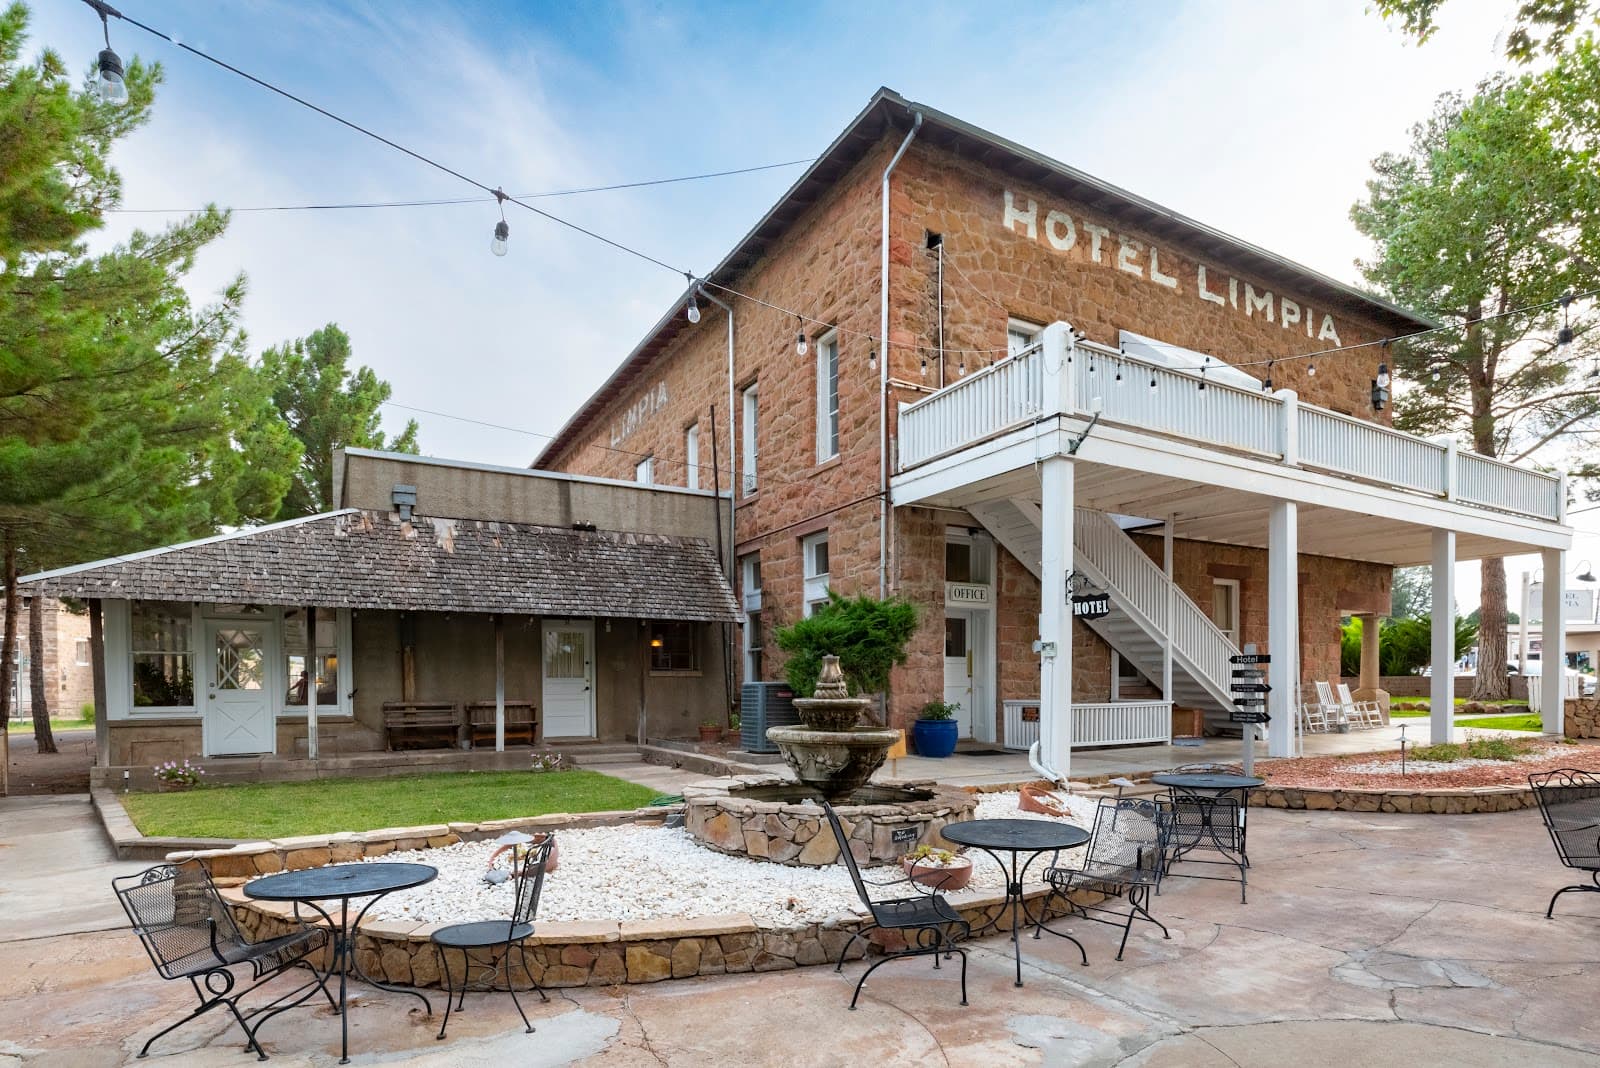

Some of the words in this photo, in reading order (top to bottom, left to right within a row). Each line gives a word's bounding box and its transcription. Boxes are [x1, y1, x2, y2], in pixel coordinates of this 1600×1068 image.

[1003, 190, 1177, 288] HOTEL
[1198, 264, 1341, 347] LIMPIA
[611, 380, 669, 448] LIMPIA
[954, 587, 985, 600] OFFICE
[1074, 600, 1109, 615] HOTEL
[1236, 655, 1258, 663] Hotel
